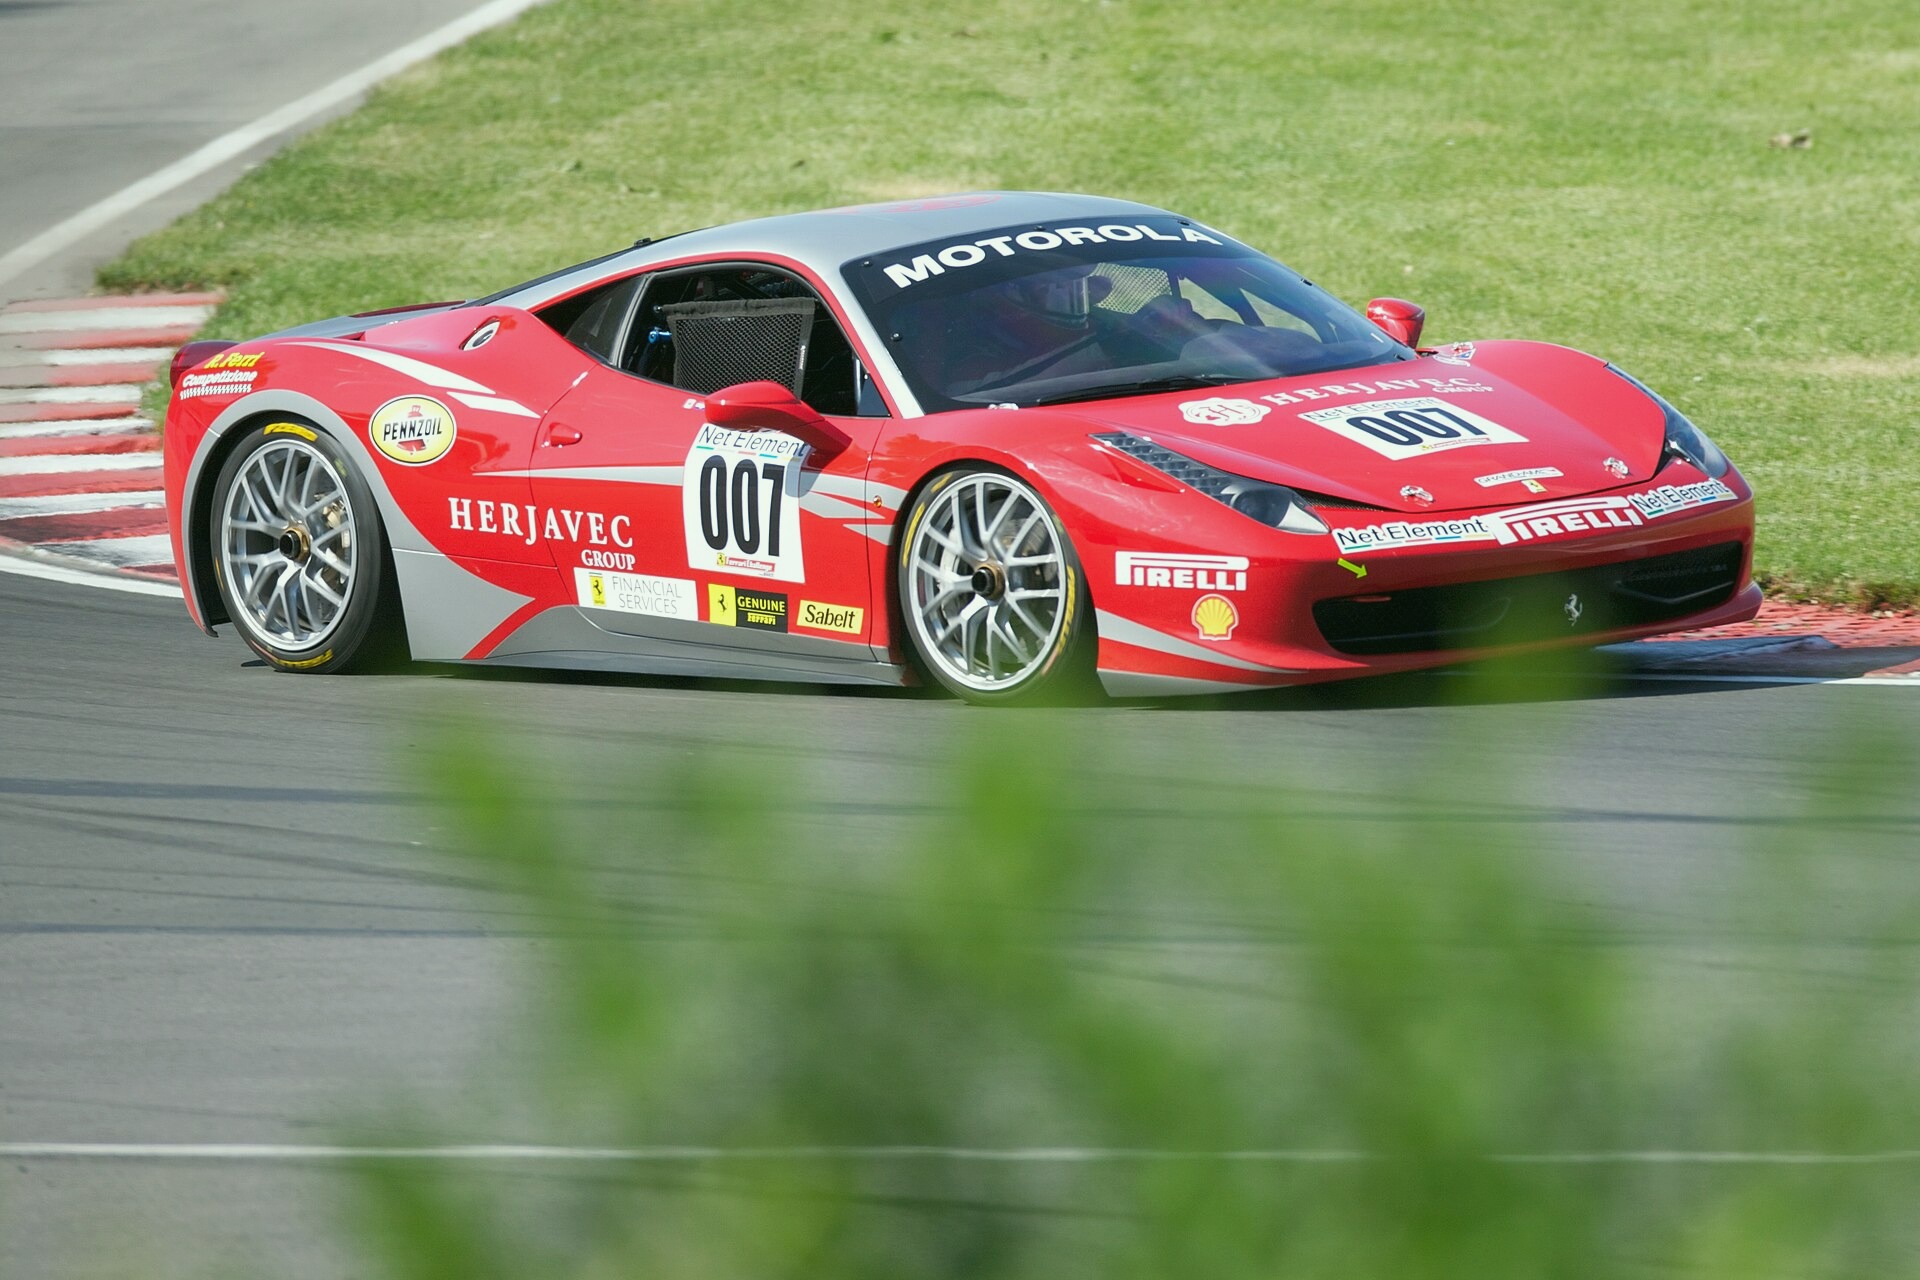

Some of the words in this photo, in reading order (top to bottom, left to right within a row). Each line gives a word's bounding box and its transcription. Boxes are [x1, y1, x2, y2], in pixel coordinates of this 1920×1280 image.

[883, 224, 1223, 289] MOTOROLA
[182, 369, 258, 388] Competizione
[1260, 377, 1481, 406] HERJAVEC
[383, 417, 442, 441] PENNZOIL
[1346, 407, 1487, 446] 007
[699, 426, 735, 446] Net
[733, 433, 807, 457] Element
[700, 454, 785, 557] 007
[1632, 496, 1661, 512] Net
[1661, 480, 1730, 502] Element
[448, 497, 633, 548] HERJAVEC
[1337, 528, 1385, 545] Net
[1386, 519, 1486, 540] Element
[1481, 496, 1644, 545] PIRELLI
[581, 549, 635, 571] GROUP
[1115, 551, 1250, 591] PIRELLI
[612, 576, 682, 598] FINANCIAL
[618, 593, 678, 614] SERVICES
[737, 595, 786, 612] GENUINE
[804, 603, 856, 629] Sabelt
